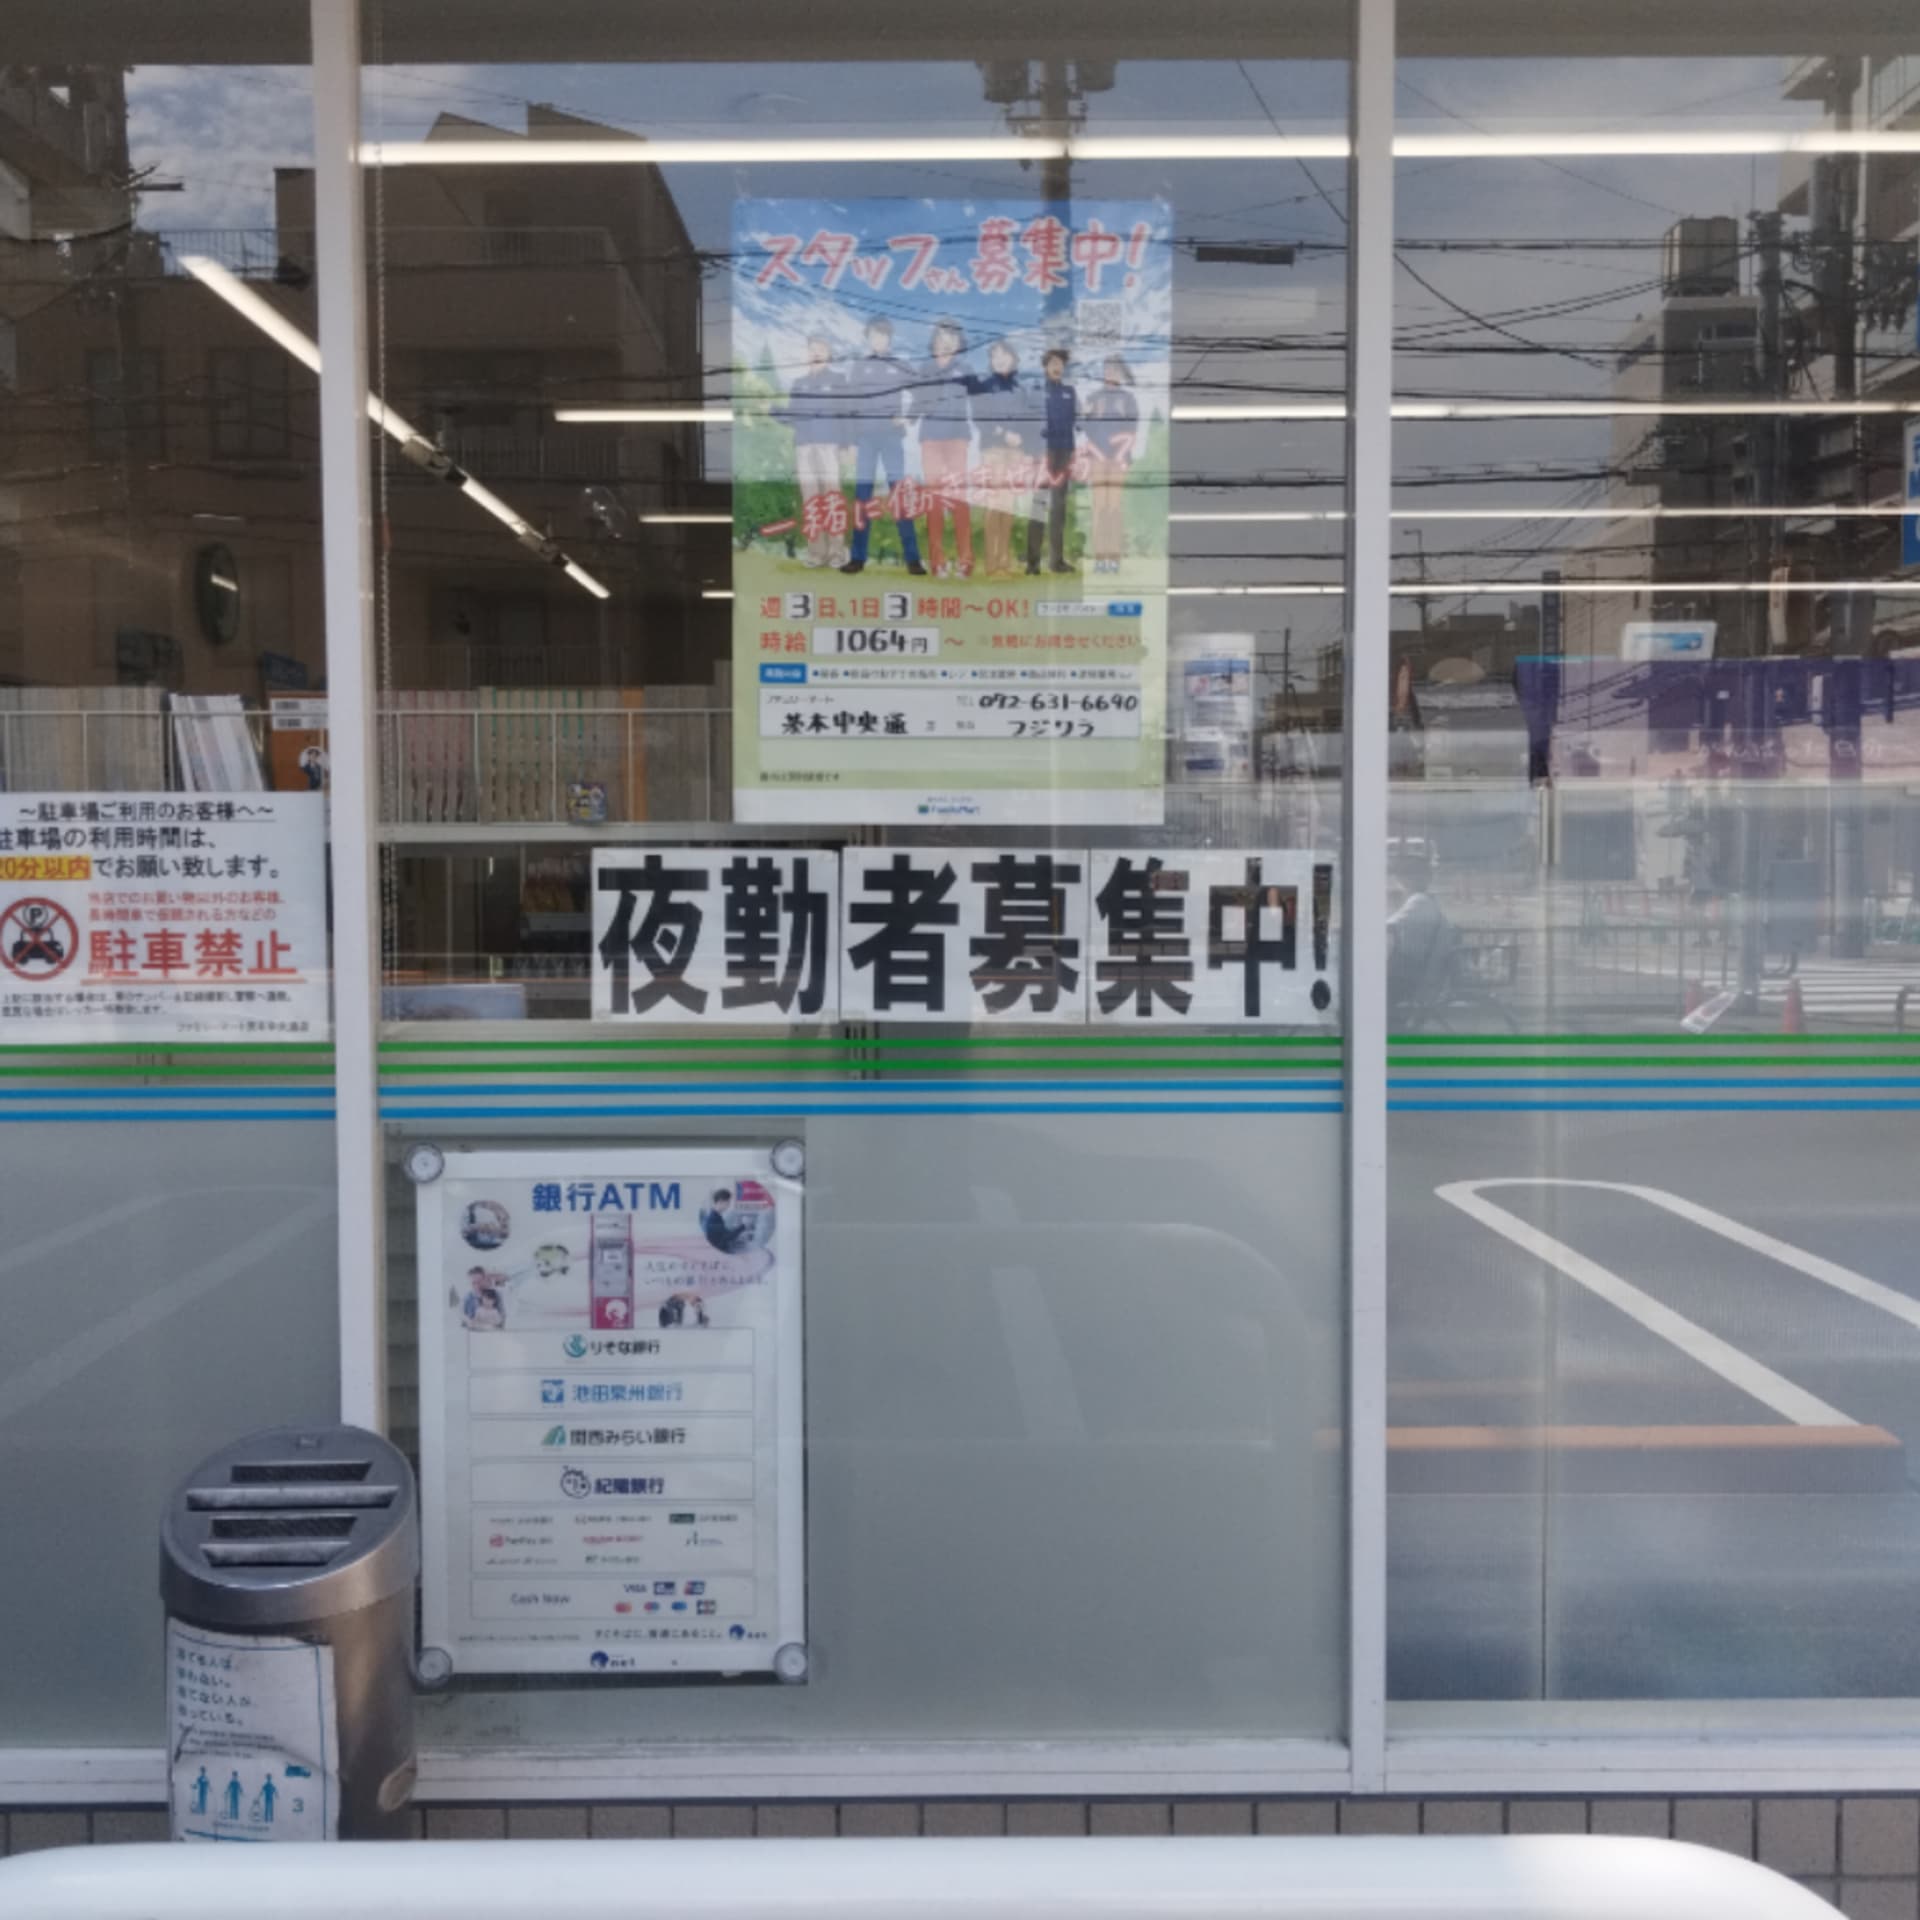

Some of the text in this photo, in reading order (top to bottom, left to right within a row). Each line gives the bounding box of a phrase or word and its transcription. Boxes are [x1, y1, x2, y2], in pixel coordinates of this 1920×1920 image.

[756, 216, 1150, 293] スタッフさん募集中!
[88, 929, 298, 978] 駐車禁止
[597, 855, 1333, 1018] 夜勤者募集中!
[532, 1182, 681, 1212] 銀行ATM
[590, 1339, 661, 1355] りそな銀行
[570, 1427, 687, 1446] 関西みらい銀行
